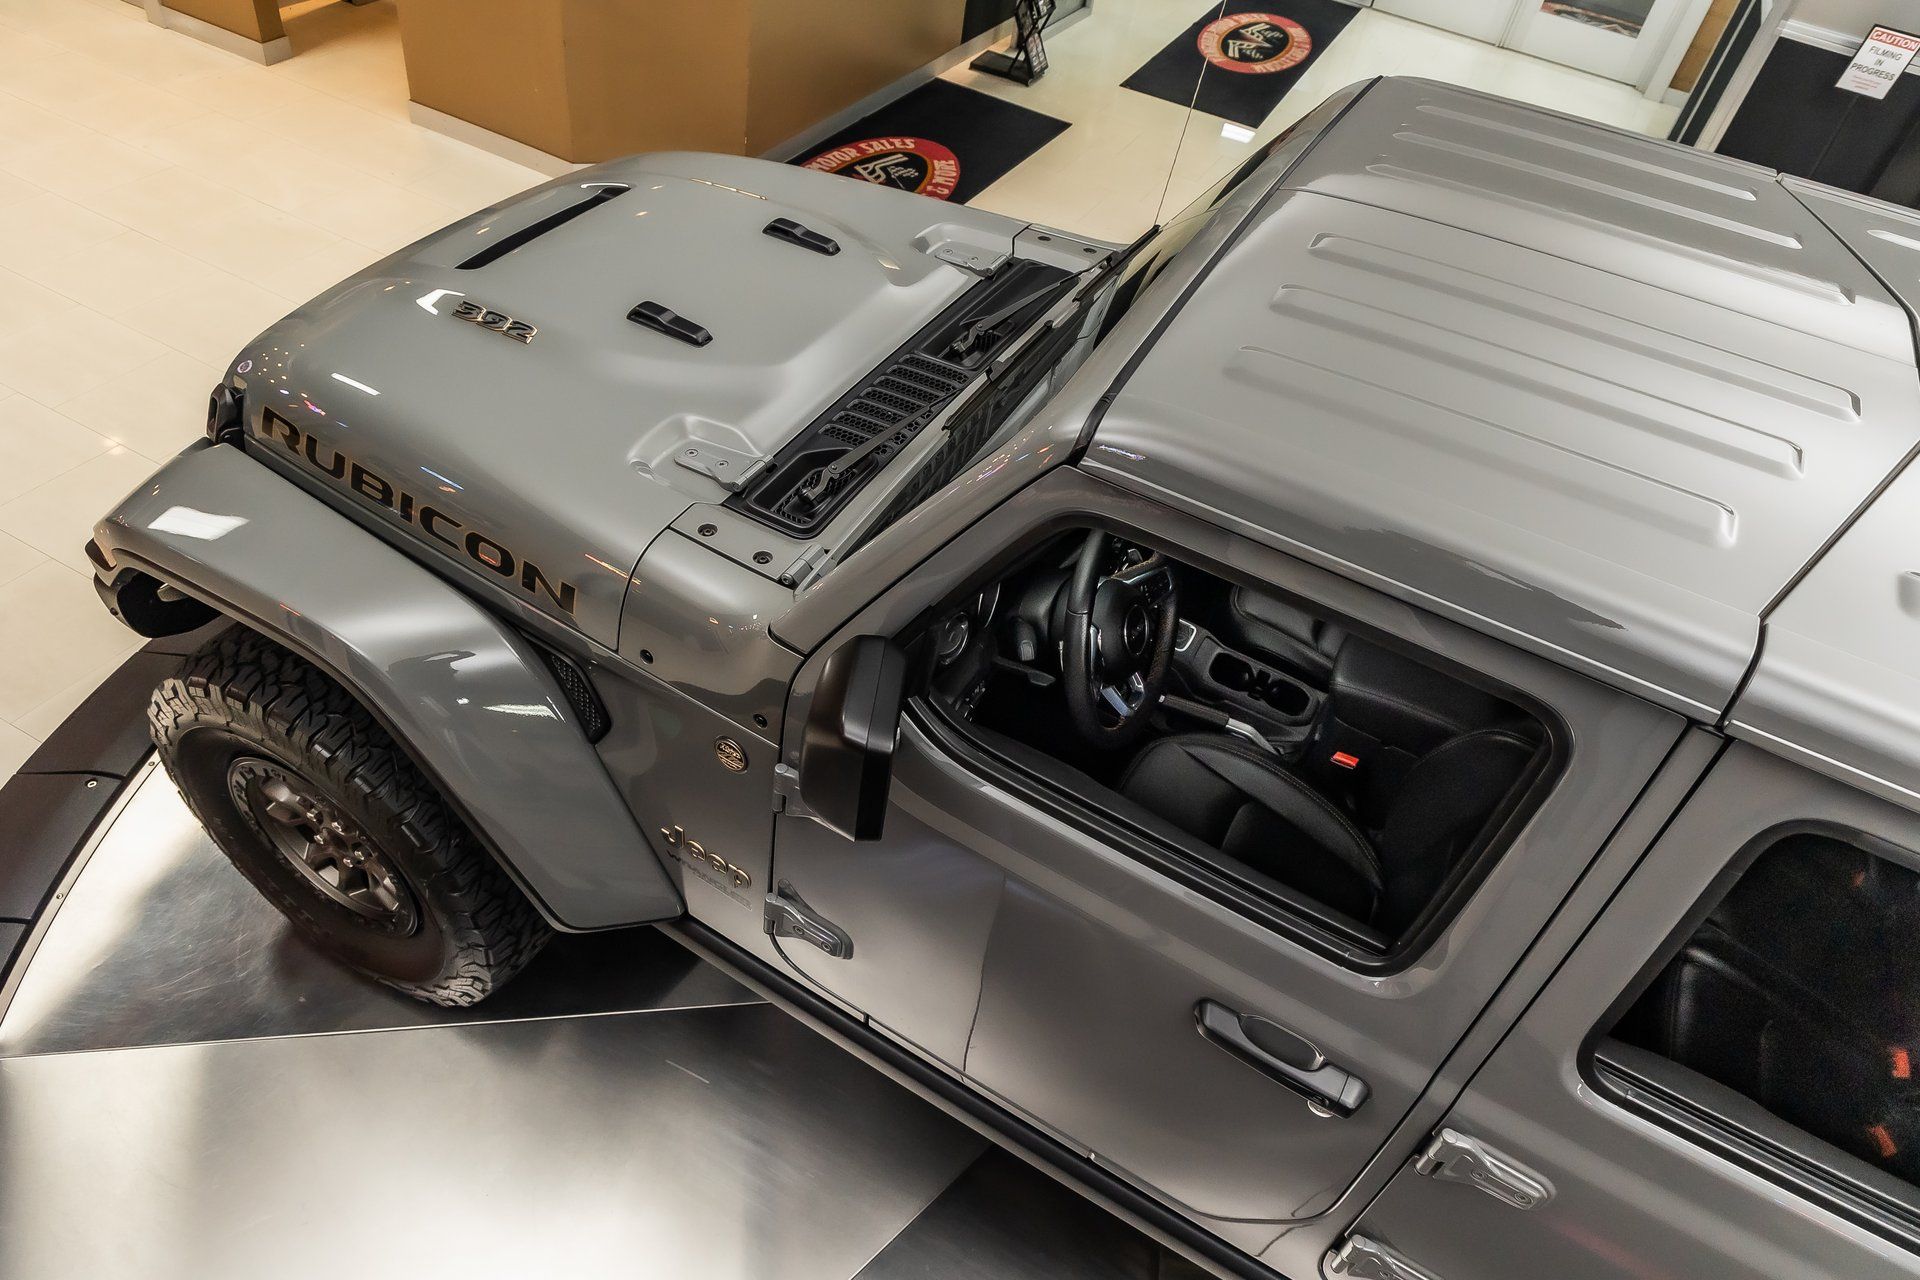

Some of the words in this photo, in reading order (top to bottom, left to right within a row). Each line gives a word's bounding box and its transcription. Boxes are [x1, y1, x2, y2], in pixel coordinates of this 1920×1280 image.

[1869, 45, 1903, 61] FILMING
[1873, 30, 1919, 50] CAUTION
[1849, 62, 1896, 81] PROGRESS
[1873, 58, 1884, 67] IN
[805, 147, 859, 172] MOTOR
[855, 138, 916, 154] SALES
[931, 159, 956, 187] MORE
[451, 300, 538, 345] 392
[260, 405, 577, 616] RUBICON
[661, 825, 752, 889] Jeep
